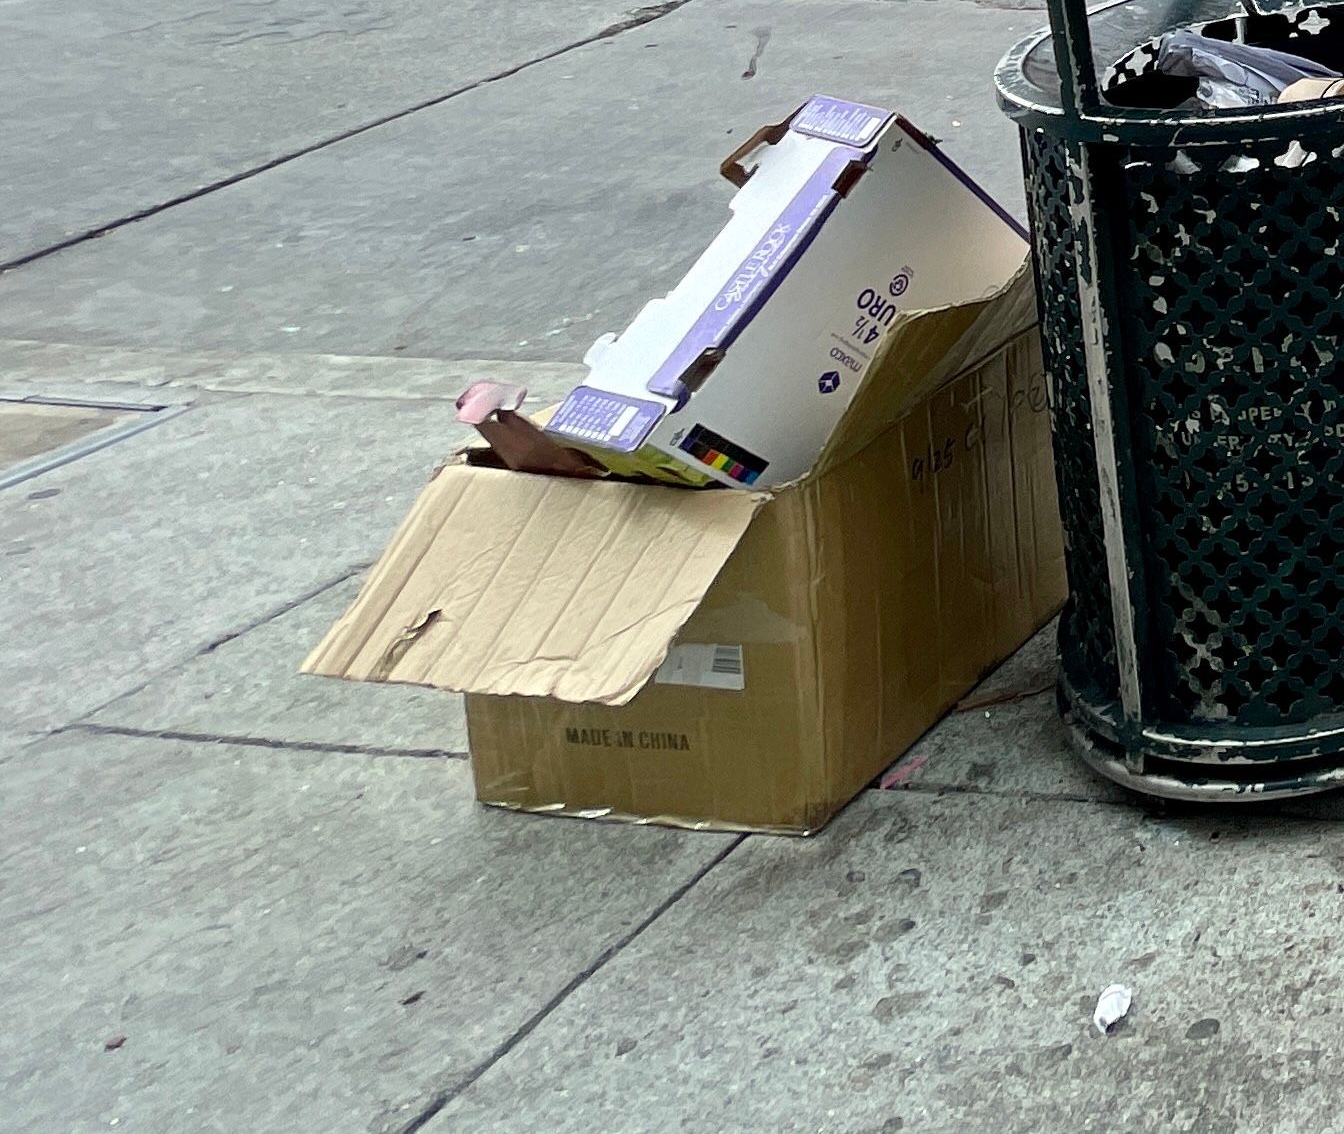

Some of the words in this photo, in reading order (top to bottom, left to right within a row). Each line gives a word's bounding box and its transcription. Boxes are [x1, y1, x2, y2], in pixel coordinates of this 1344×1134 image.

[565, 727, 610, 747] MADE
[618, 730, 634, 748] IN
[638, 731, 691, 751] CHINA
